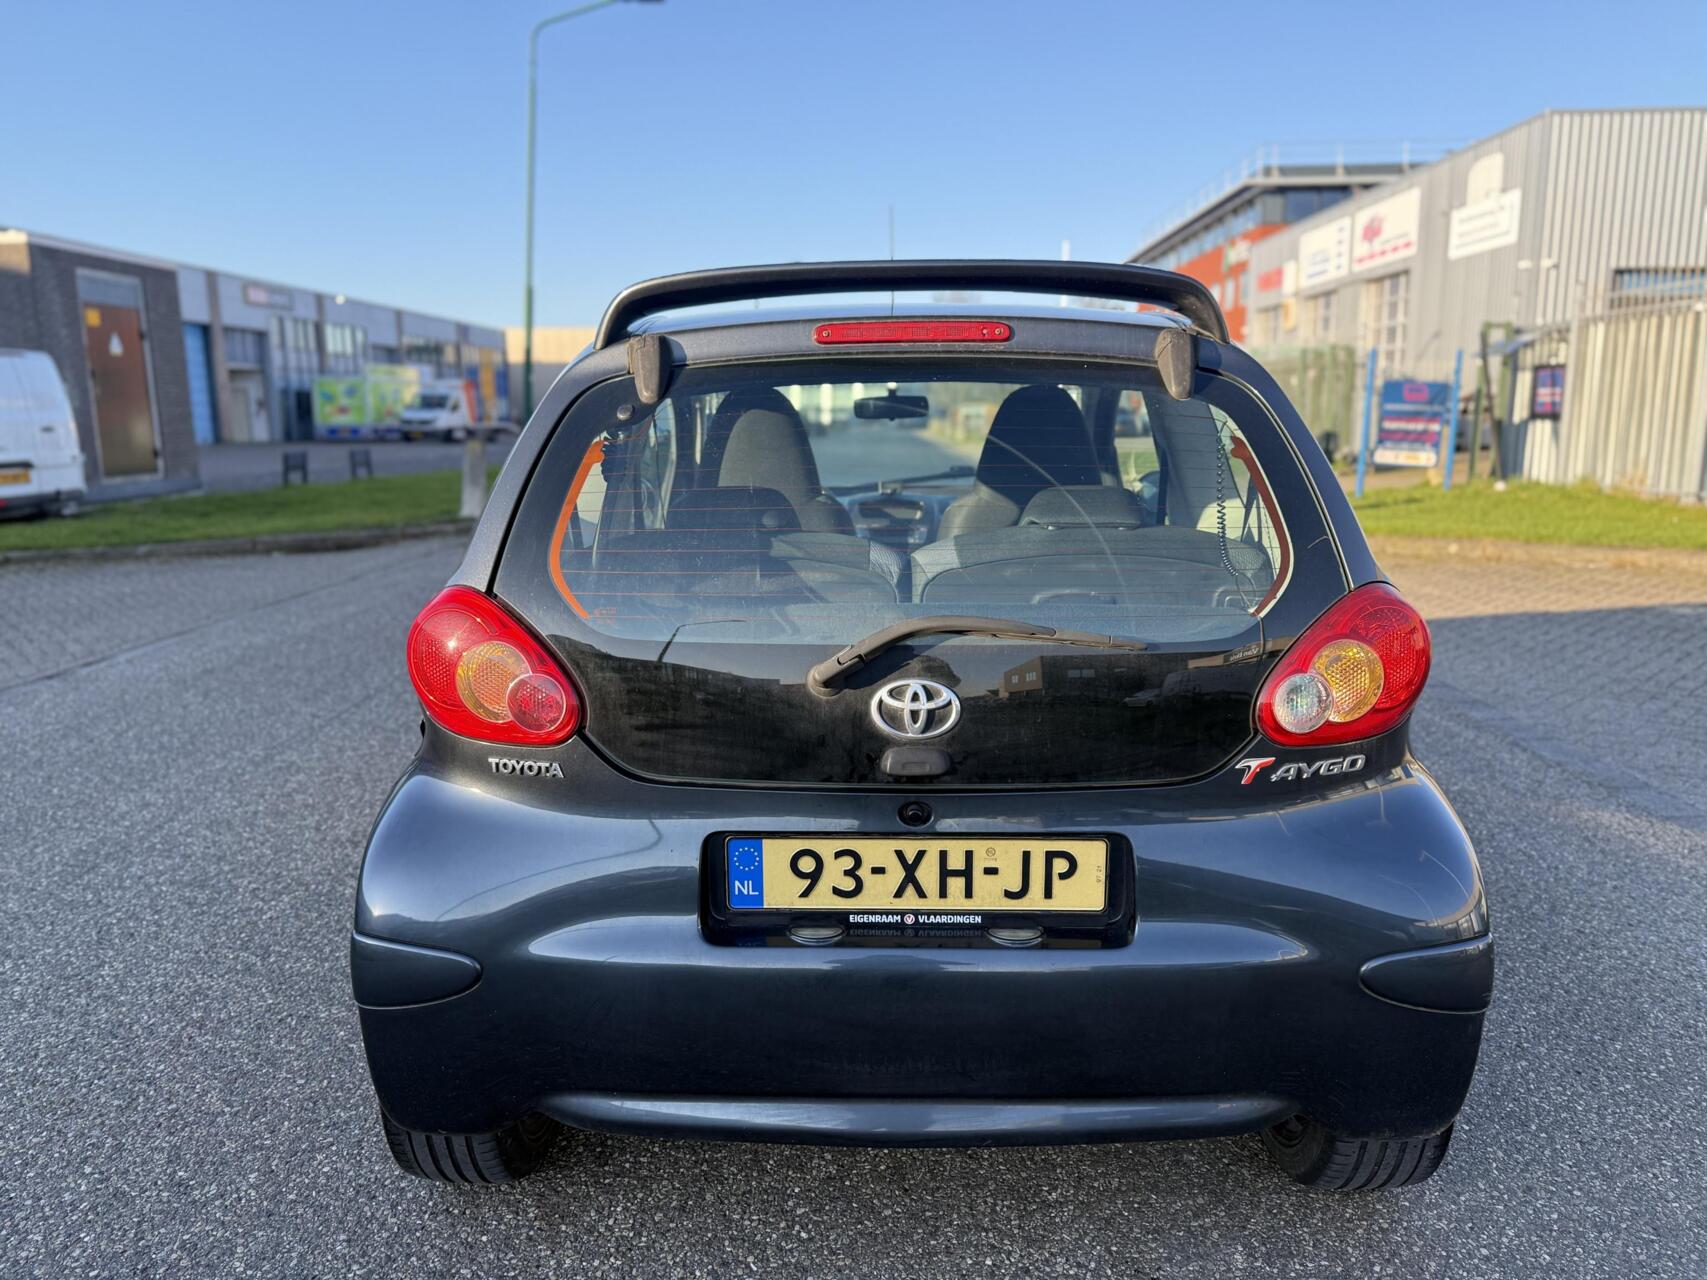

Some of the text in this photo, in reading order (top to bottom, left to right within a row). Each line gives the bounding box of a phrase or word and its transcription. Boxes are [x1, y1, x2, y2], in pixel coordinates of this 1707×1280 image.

[487, 757, 565, 779] TOYOTA
[1270, 753, 1367, 783] AYGO
[789, 848, 1078, 900] 93-XH-JP
[734, 880, 760, 896] NL
[849, 914, 901, 923] EIGENRAAM
[918, 915, 982, 924] VLAARDINGEN
